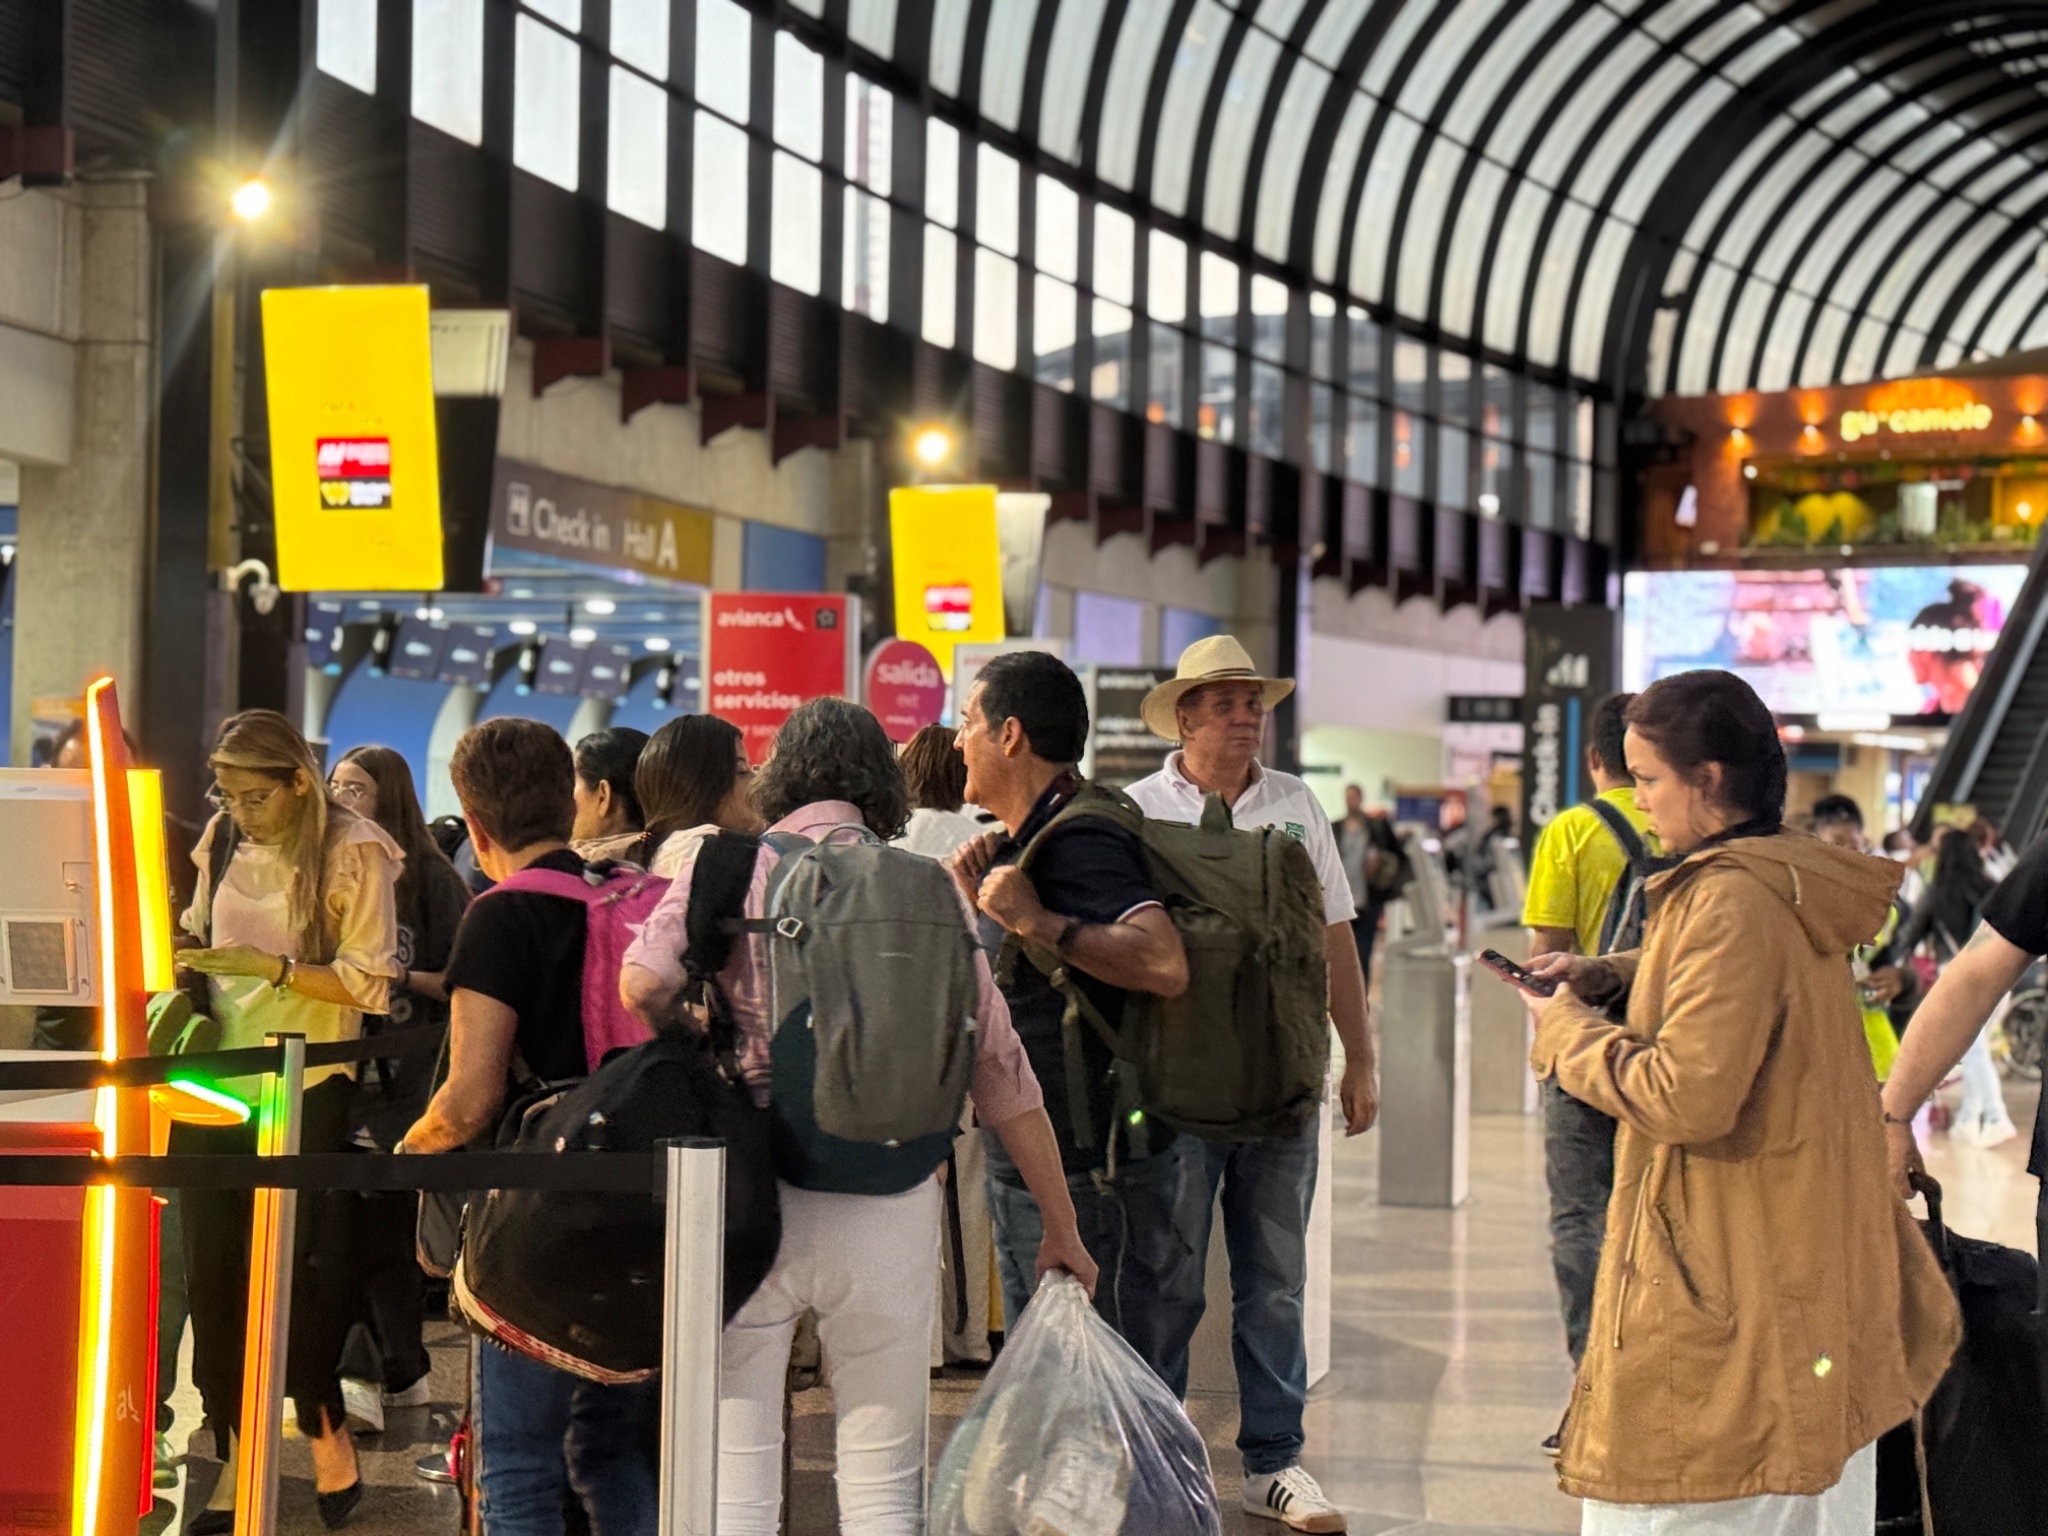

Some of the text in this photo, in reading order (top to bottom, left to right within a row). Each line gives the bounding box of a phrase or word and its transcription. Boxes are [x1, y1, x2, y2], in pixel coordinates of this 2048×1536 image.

[533, 498, 590, 549] Check
[592, 513, 611, 553] in
[656, 518, 679, 571] A
[717, 608, 784, 627] avianca
[713, 669, 766, 687] otros
[877, 659, 939, 688] salida
[713, 690, 801, 709] servicios
